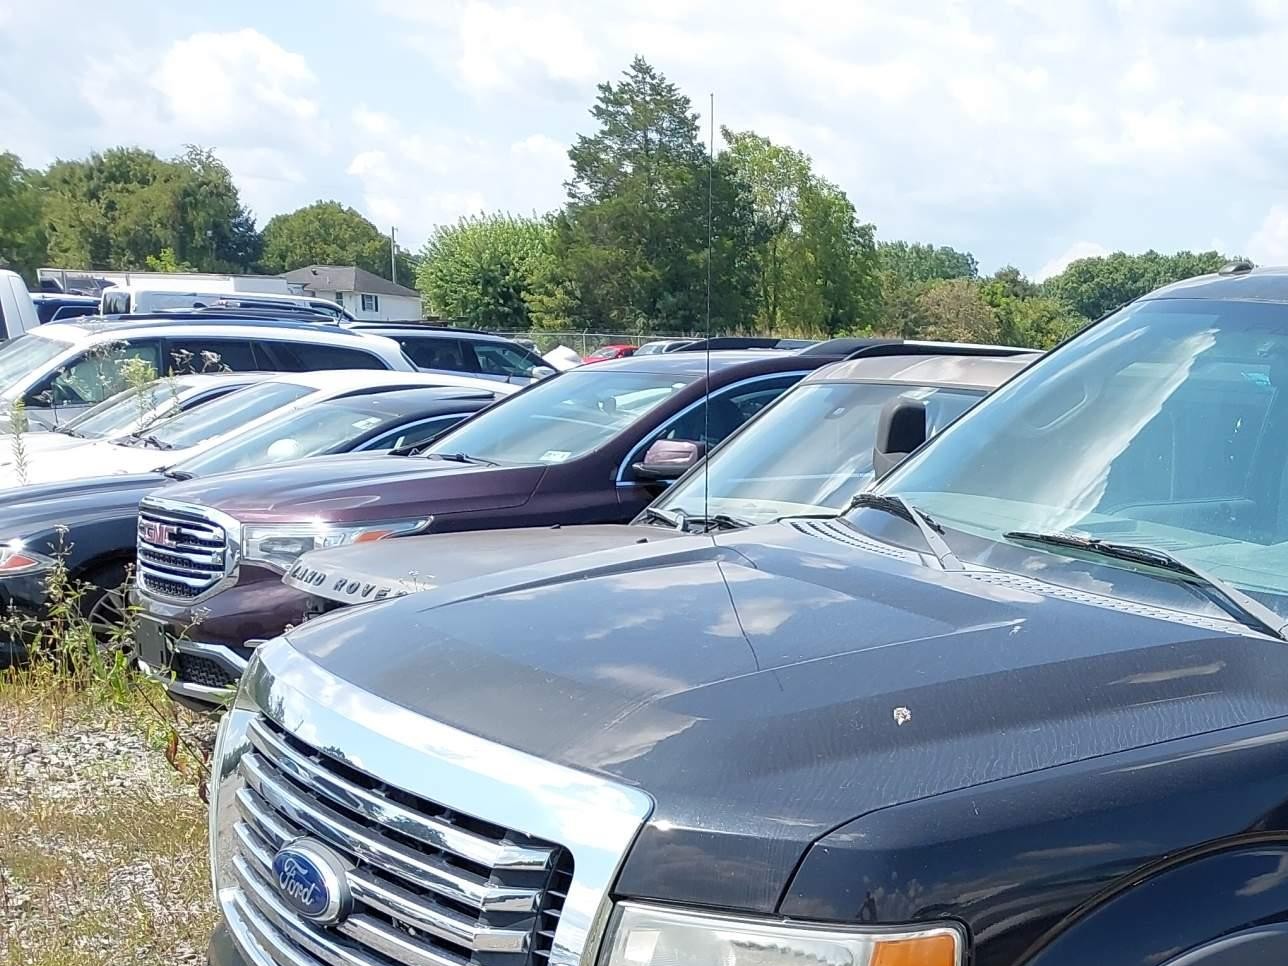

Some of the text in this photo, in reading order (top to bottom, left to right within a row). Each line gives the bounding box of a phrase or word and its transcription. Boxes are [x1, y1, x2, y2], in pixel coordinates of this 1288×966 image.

[143, 521, 177, 549] GMC
[290, 565, 327, 586] LAND
[280, 858, 314, 906] Ford
